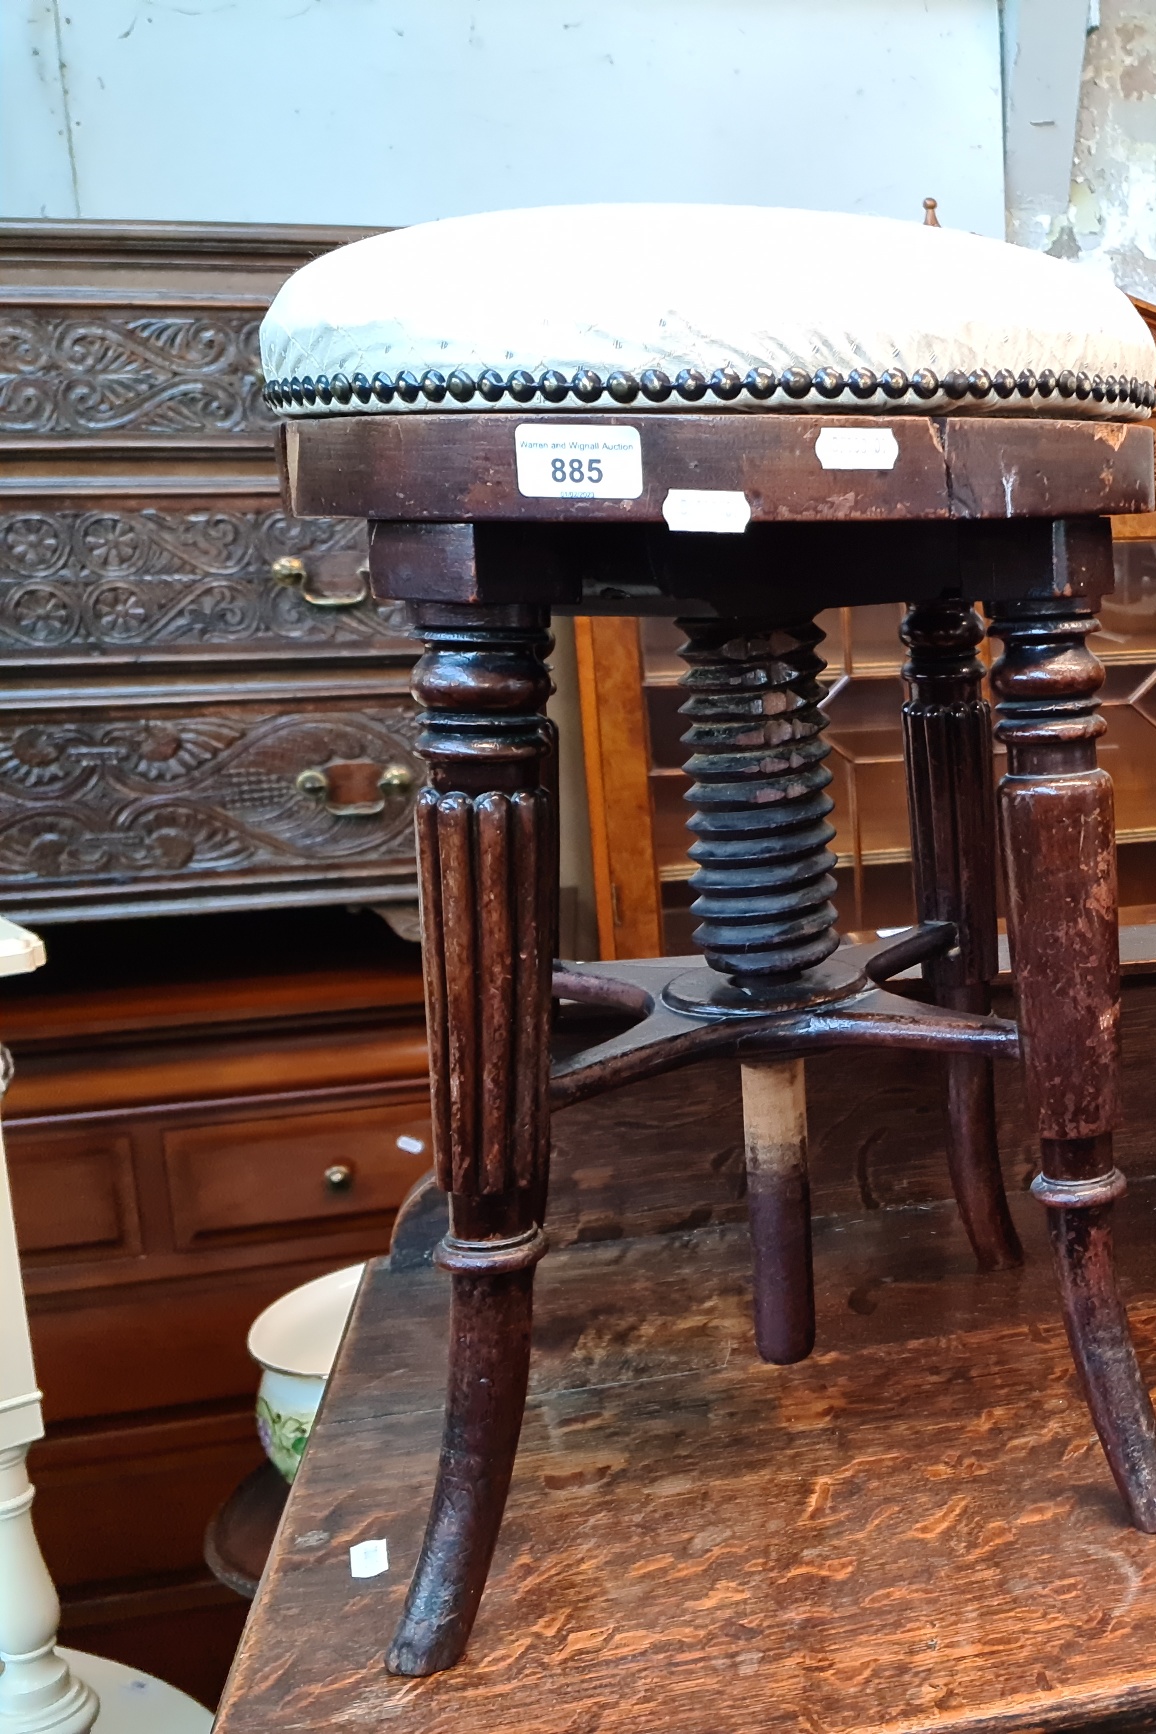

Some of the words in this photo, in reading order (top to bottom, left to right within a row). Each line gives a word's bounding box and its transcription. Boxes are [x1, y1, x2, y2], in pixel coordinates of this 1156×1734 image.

[519, 440, 549, 450] Warren
[551, 441, 566, 450] and
[568, 441, 600, 452] Wignall
[602, 441, 634, 451] Auction
[551, 458, 603, 483] 885
